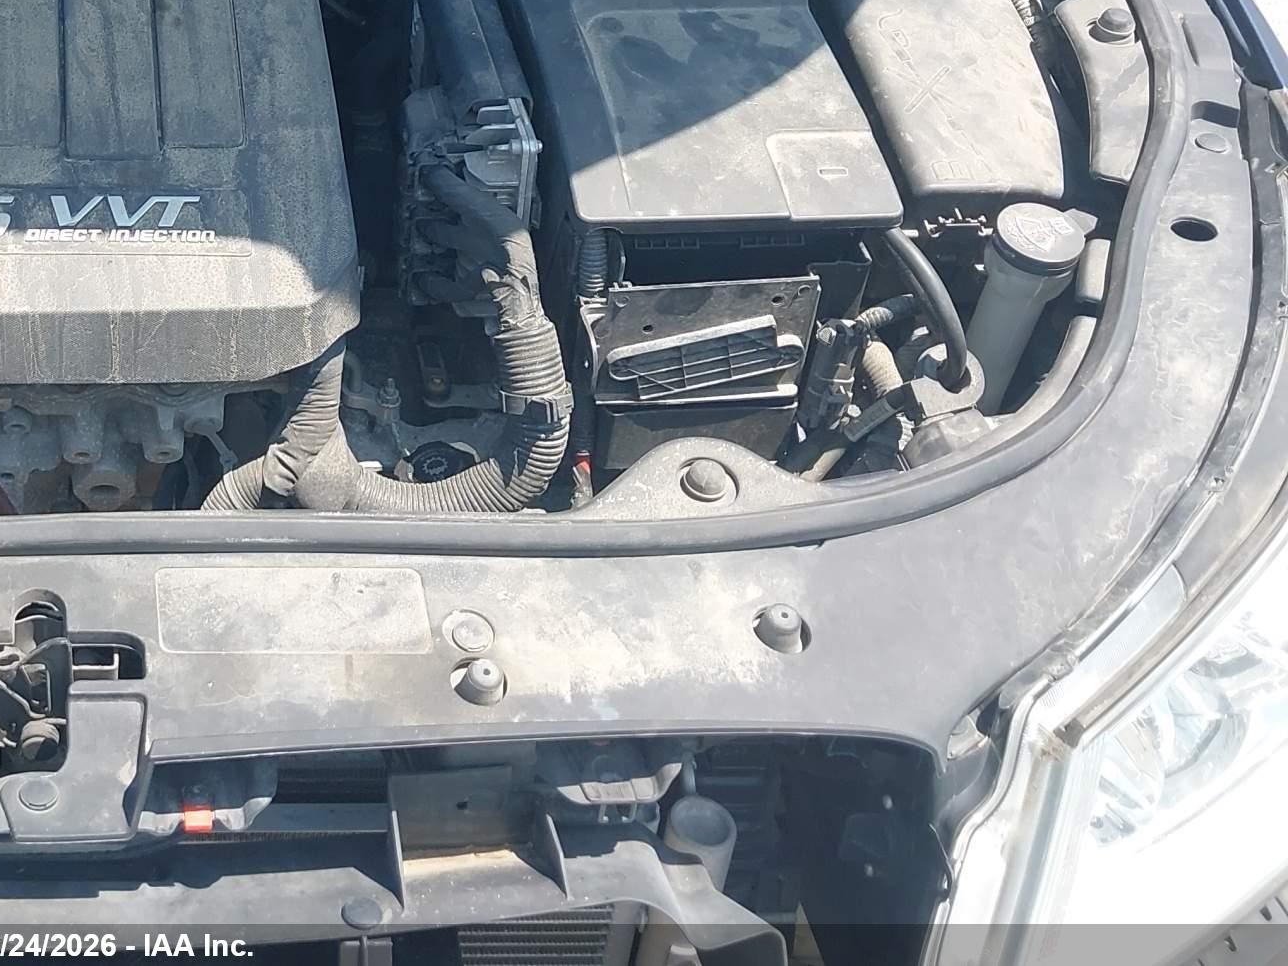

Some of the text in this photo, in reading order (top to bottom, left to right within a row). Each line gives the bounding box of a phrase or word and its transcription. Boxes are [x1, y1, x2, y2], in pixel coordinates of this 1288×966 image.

[50, 195, 201, 227] VVT
[24, 228, 216, 243] DIRECT INJECTION
